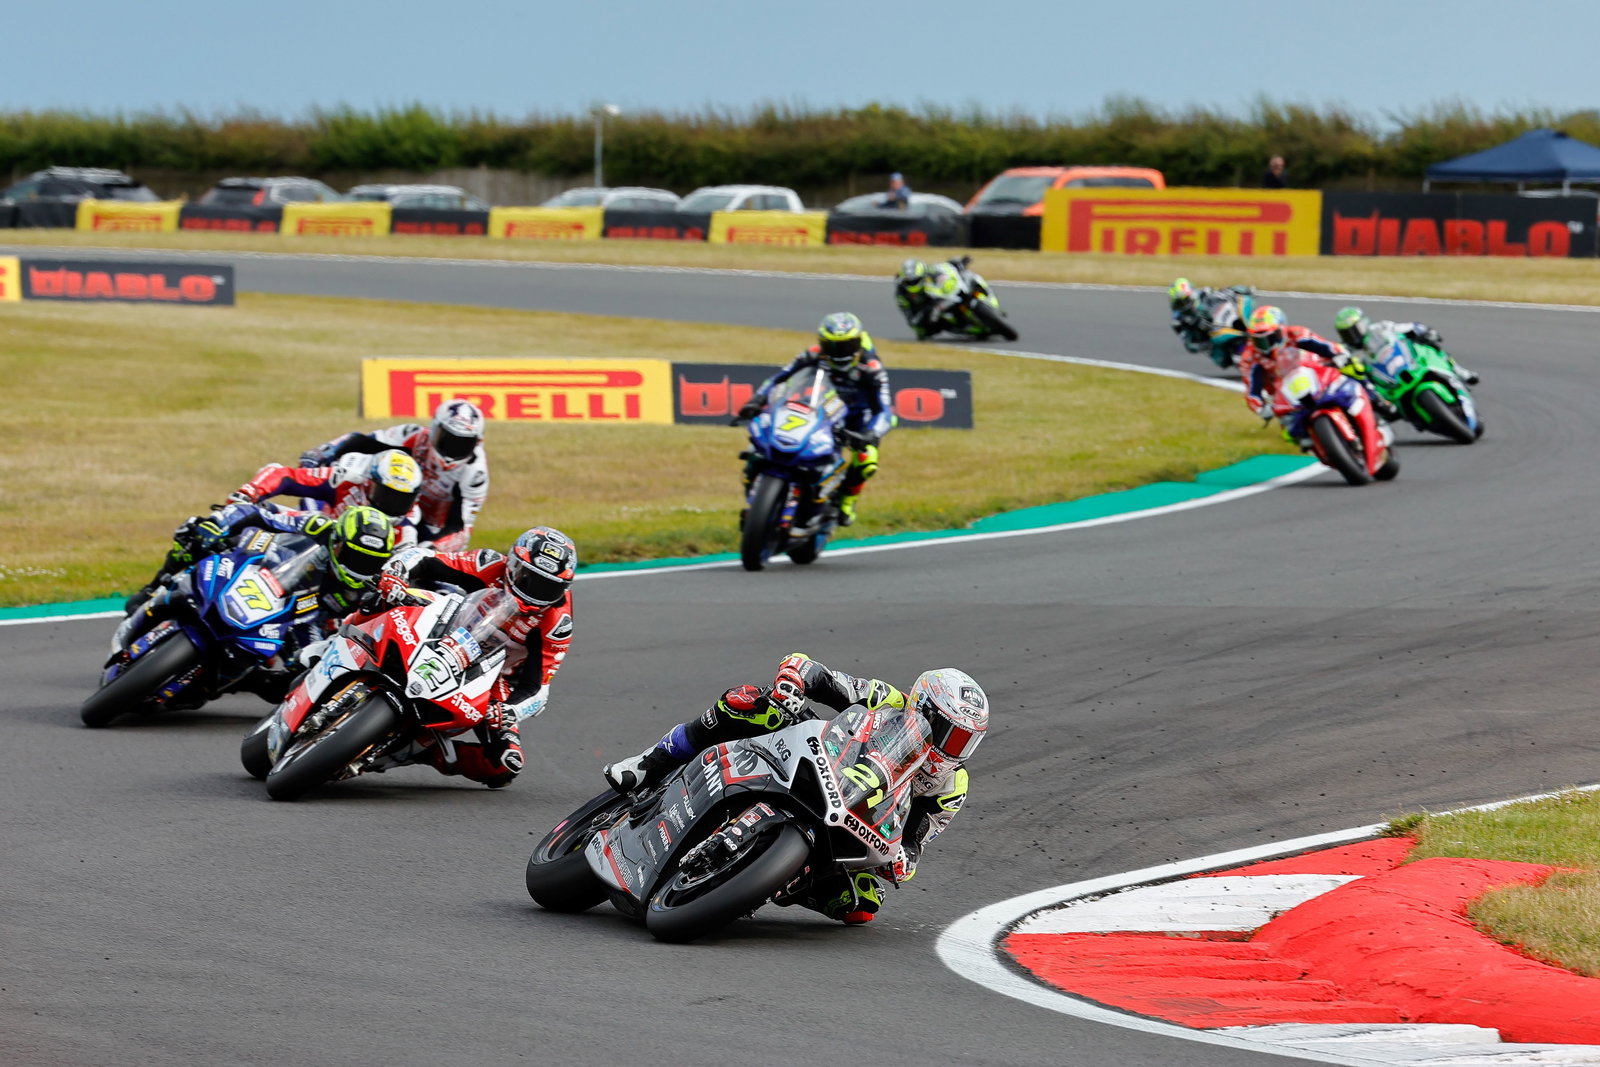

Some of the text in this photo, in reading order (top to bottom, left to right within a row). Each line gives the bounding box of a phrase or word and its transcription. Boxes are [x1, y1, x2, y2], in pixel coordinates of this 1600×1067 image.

[1067, 198, 1292, 256] PIRELLI
[1333, 206, 1571, 258] DIABLO
[29, 265, 217, 300] DIABLO
[679, 374, 945, 422] DIO
[777, 415, 807, 431] 7
[236, 579, 272, 611] 77
[775, 738, 791, 762] R&G
[815, 756, 842, 809] OXFORD
[841, 763, 884, 809] 21
[916, 773, 933, 790] R&G
[858, 824, 890, 856] OXFORD
